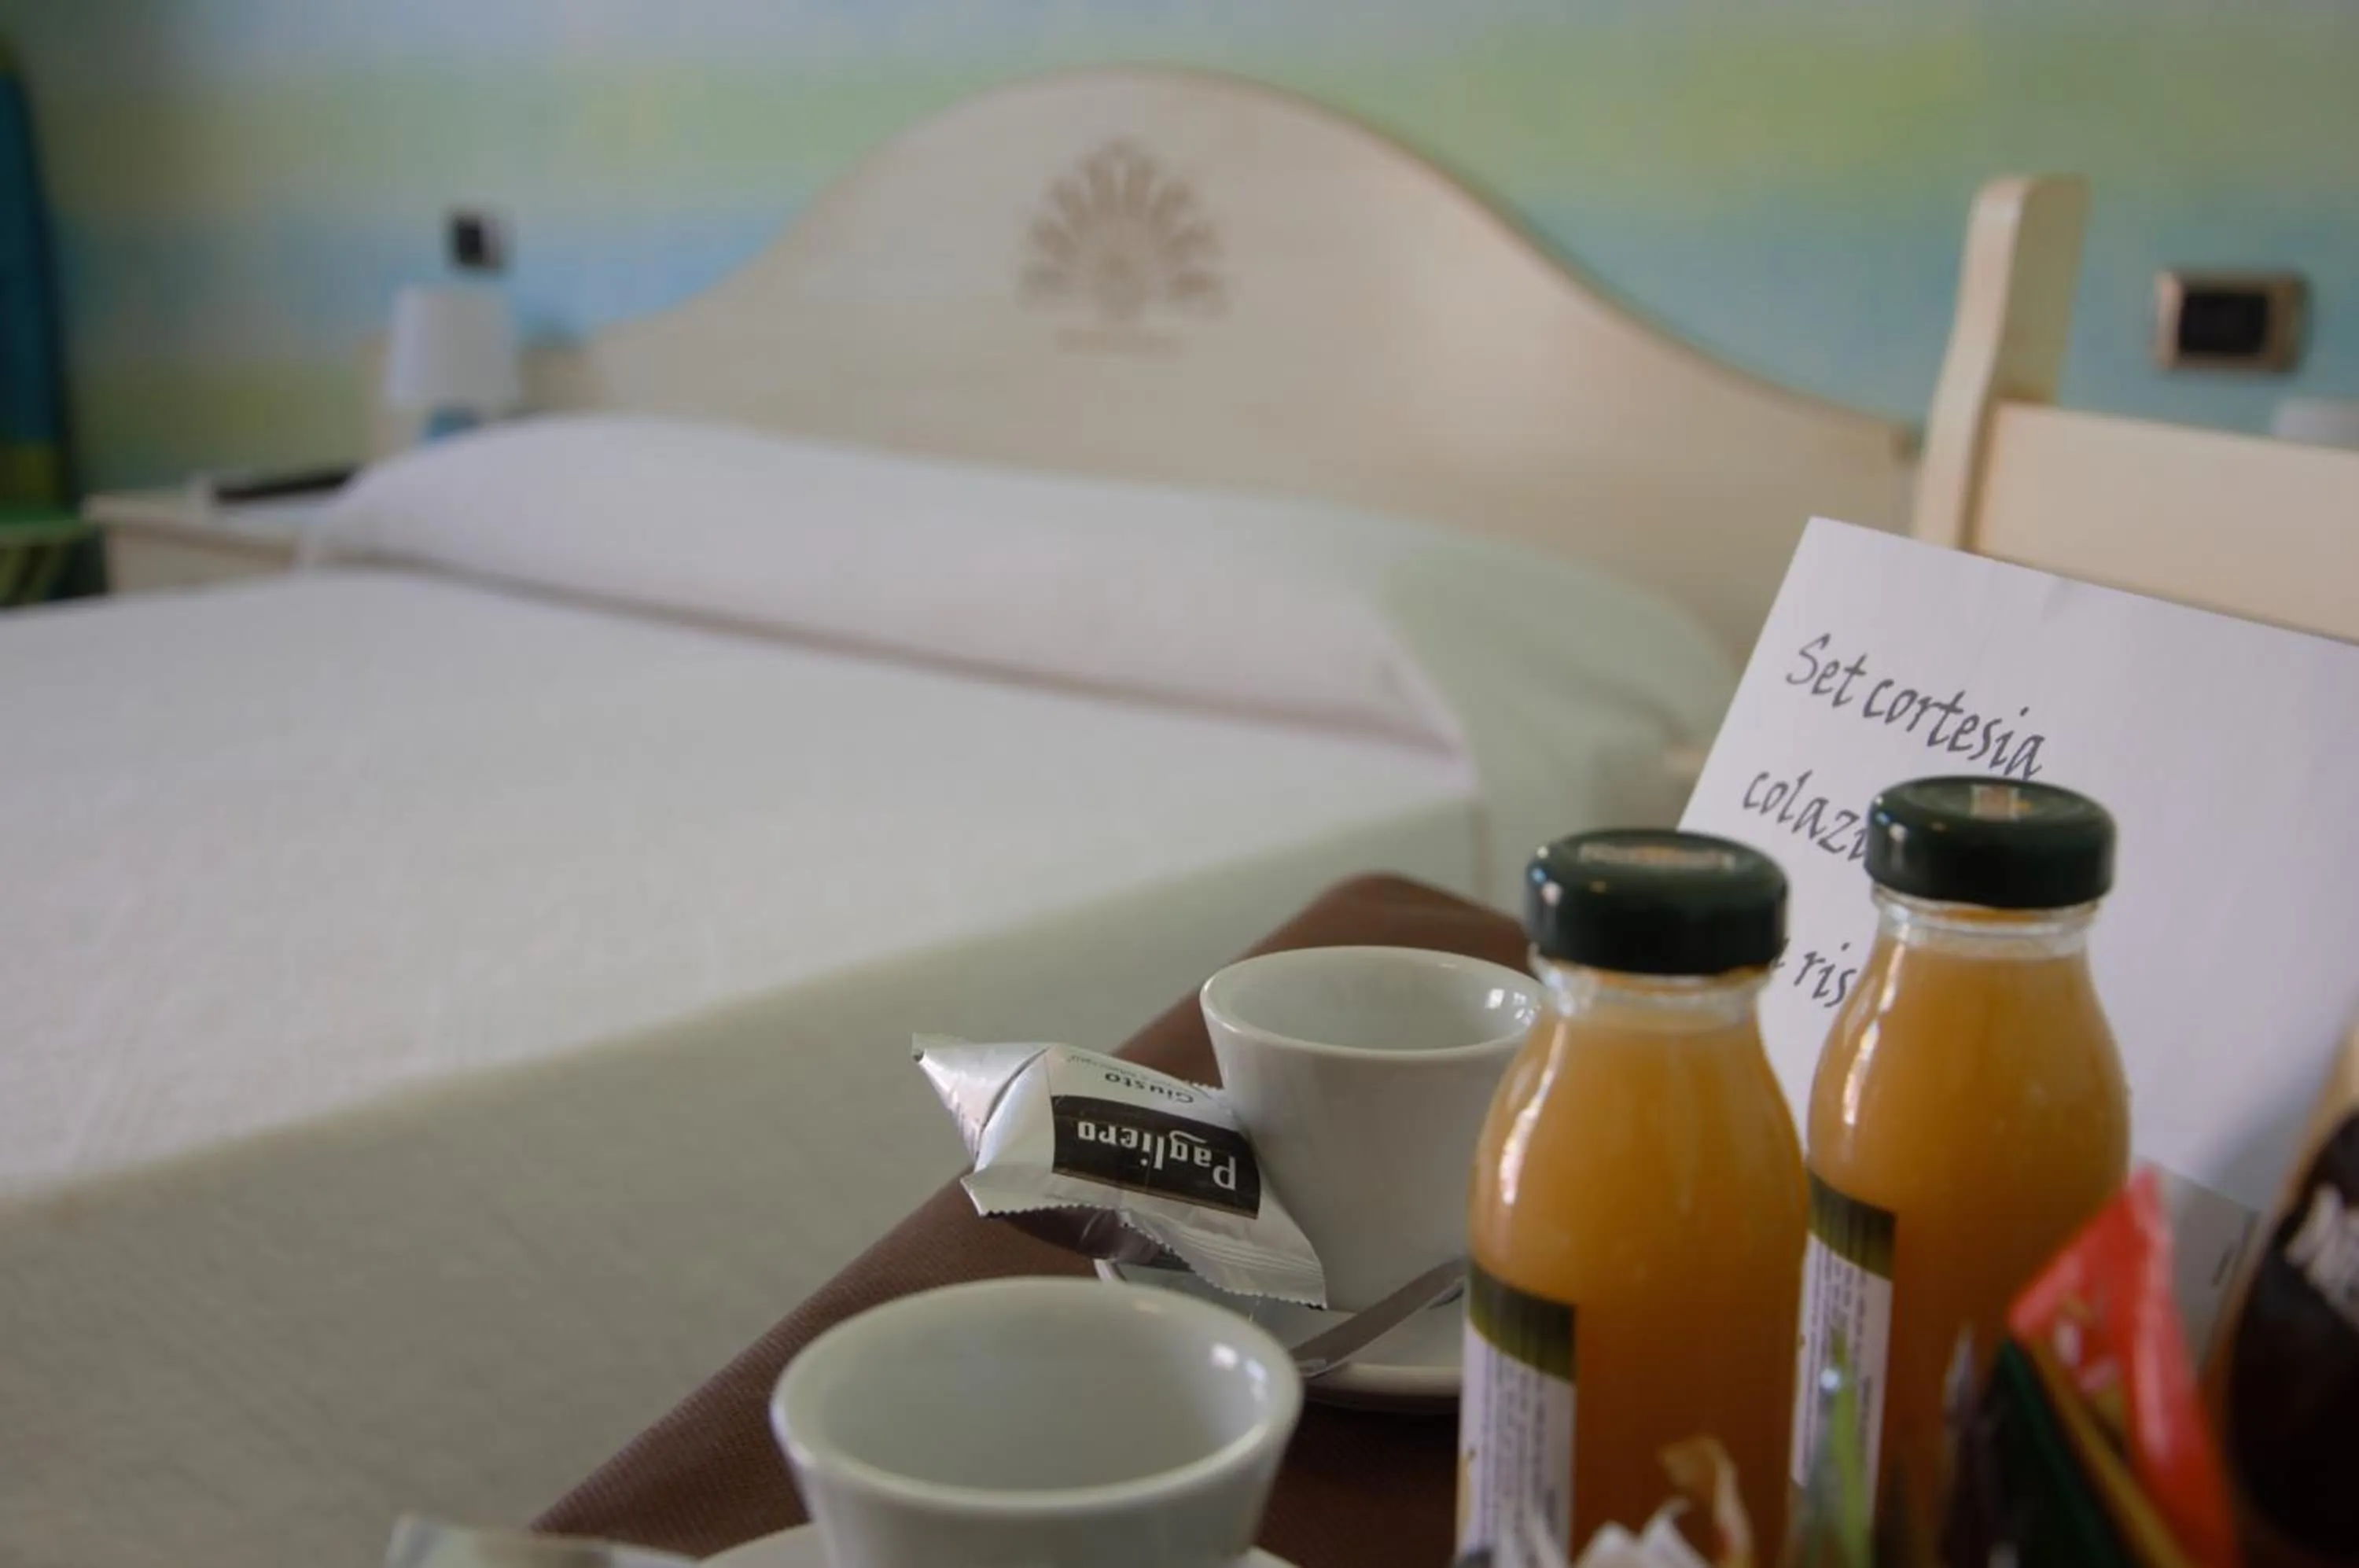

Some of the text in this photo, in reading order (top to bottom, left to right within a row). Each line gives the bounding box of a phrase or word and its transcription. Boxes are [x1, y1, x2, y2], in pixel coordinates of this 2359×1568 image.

[1786, 633, 2044, 781] Set cortesia
[1104, 1072, 1194, 1104] Giusto
[1079, 1121, 1236, 1191] Pagliero
